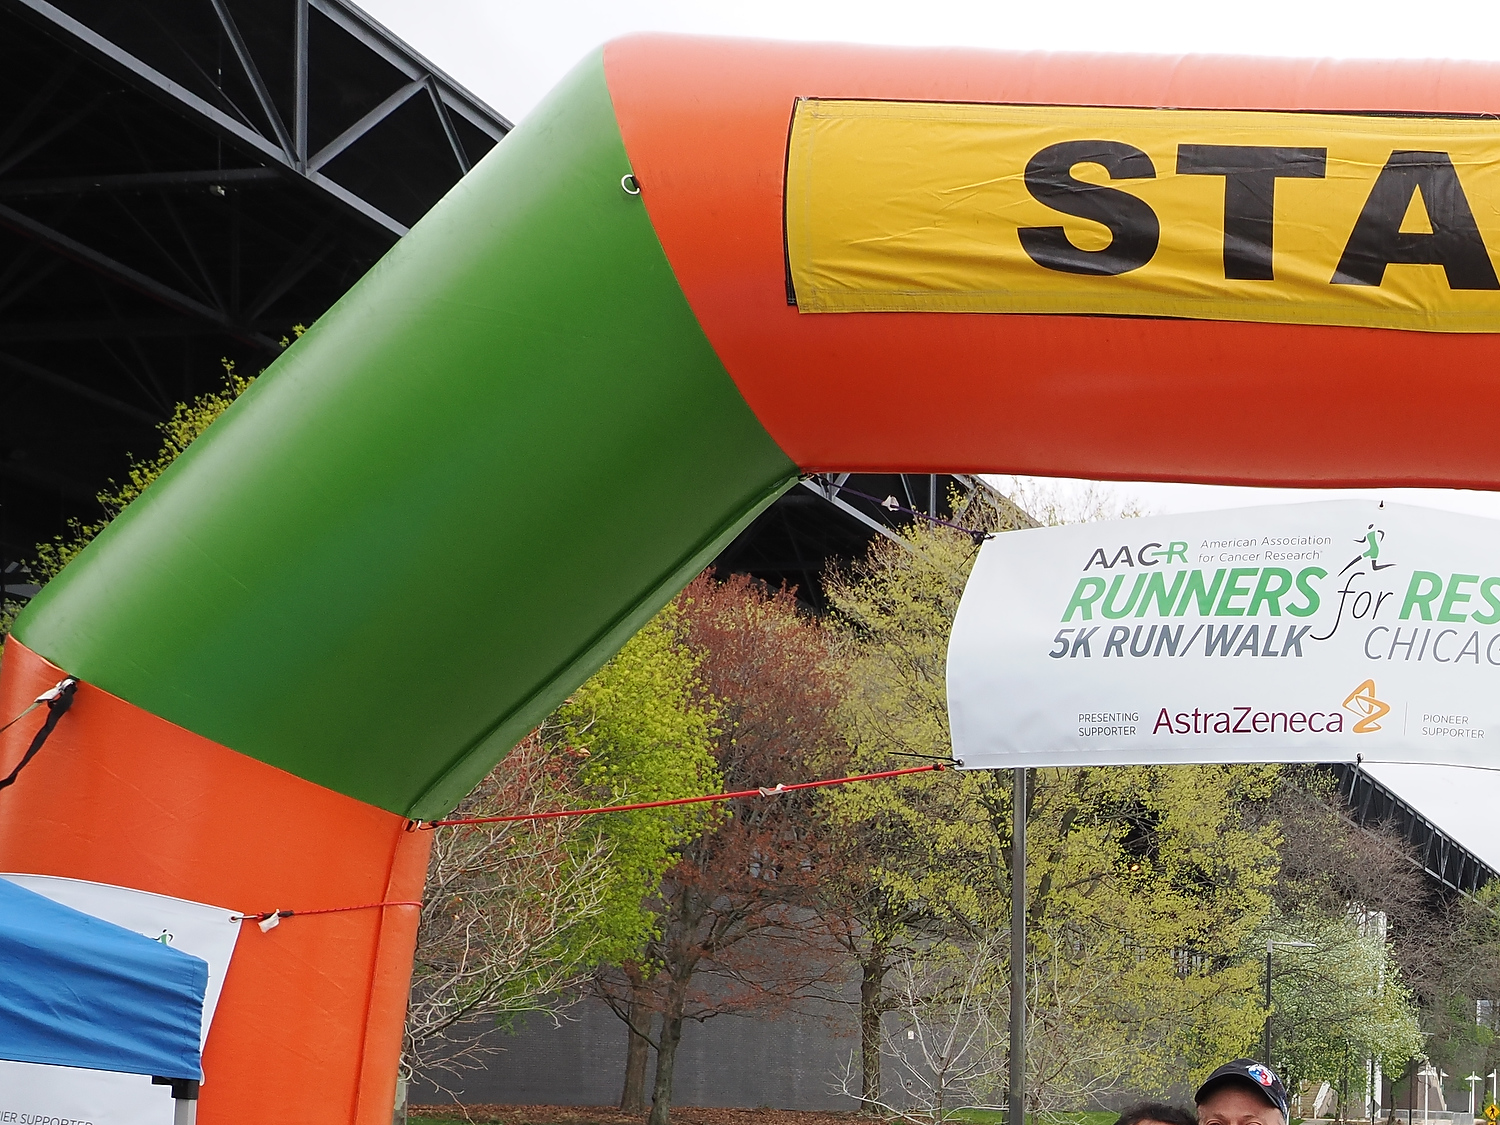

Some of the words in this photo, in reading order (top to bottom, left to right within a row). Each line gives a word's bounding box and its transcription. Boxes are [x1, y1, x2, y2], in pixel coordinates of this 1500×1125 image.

[1200, 537, 1257, 549] American
[1261, 535, 1332, 547] Association
[1083, 541, 1189, 571] AACR
[1199, 552, 1214, 563] for
[1219, 551, 1262, 563] Cancer
[1265, 549, 1321, 561] Research
[1060, 566, 1329, 623] RUNNERS
[1310, 572, 1394, 640] for
[1048, 625, 1101, 659] 5K
[1103, 624, 1312, 658] RUN/WALK
[1078, 712, 1139, 723] PRESENTING
[1152, 707, 1343, 734] AstraZeneca
[1423, 714, 1469, 725] PIONEER
[1078, 726, 1136, 737] SUPPORTER
[1422, 726, 1485, 739] SUPPORTER
